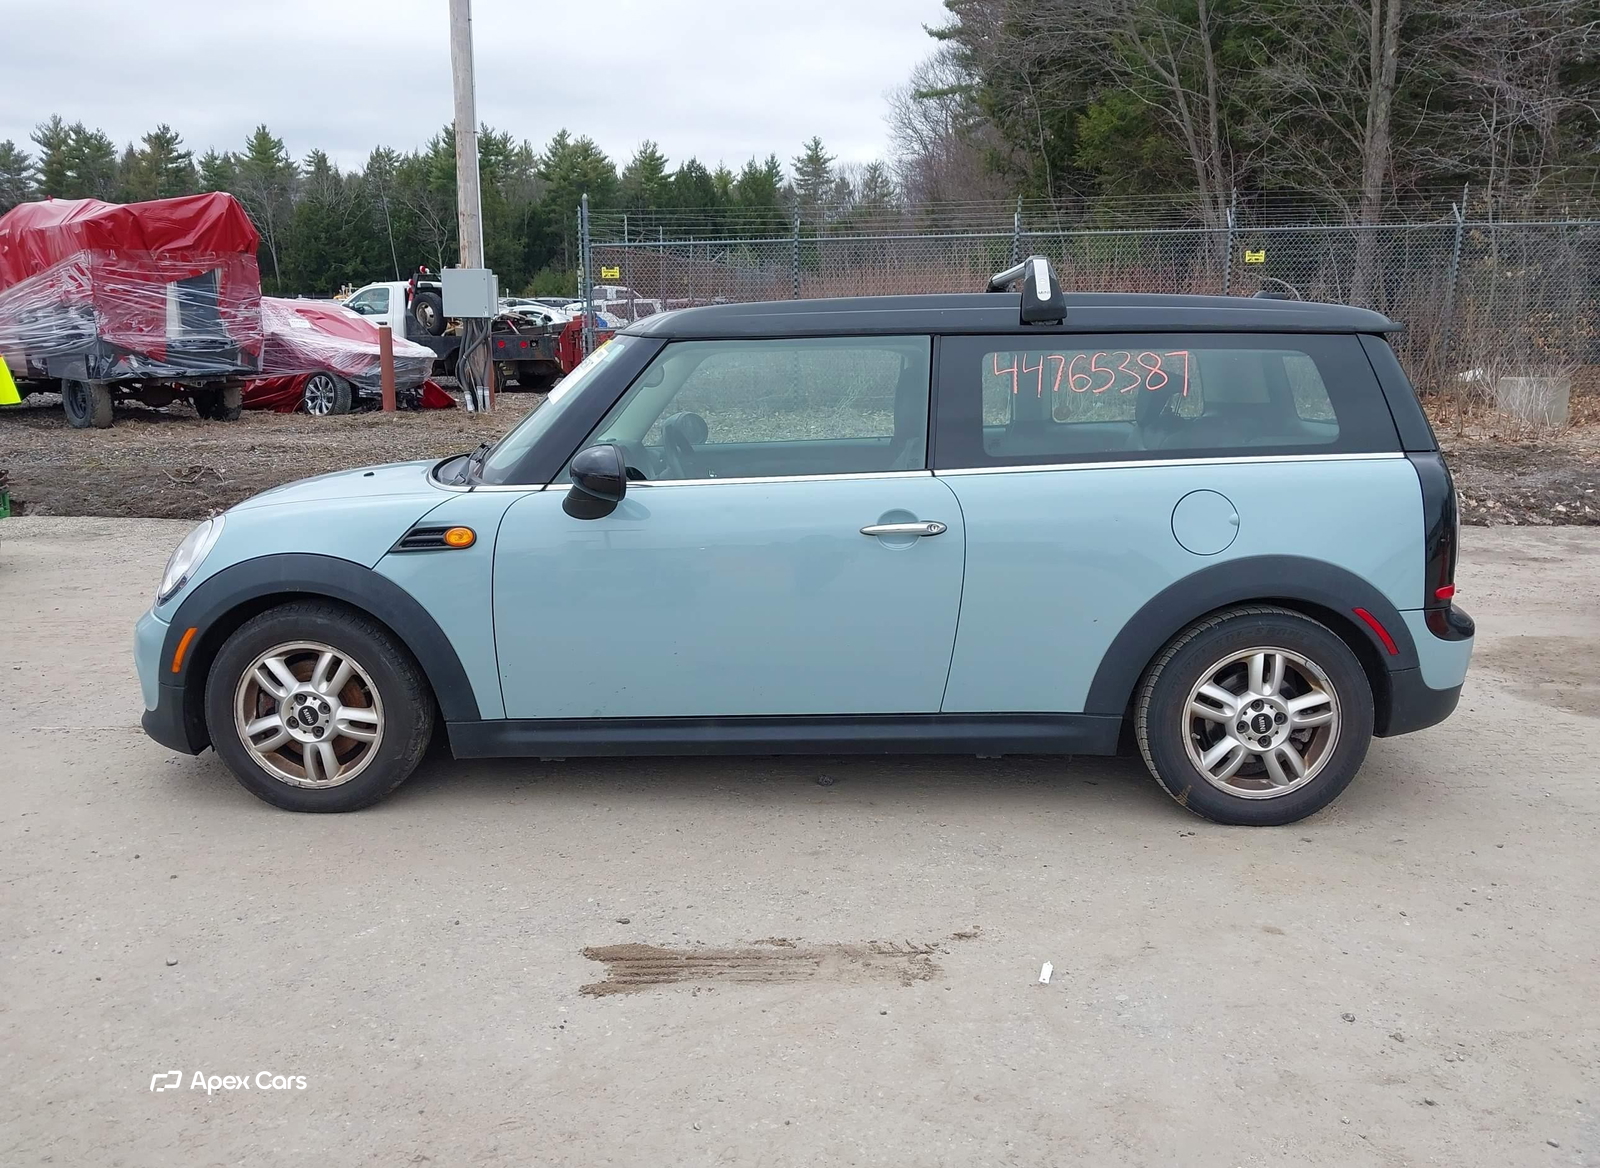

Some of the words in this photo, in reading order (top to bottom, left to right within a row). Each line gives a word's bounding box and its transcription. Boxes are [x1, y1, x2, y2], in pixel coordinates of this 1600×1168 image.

[993, 350, 1189, 398] 44765387
[303, 709, 314, 724] MINI
[1258, 716, 1266, 732] MINI
